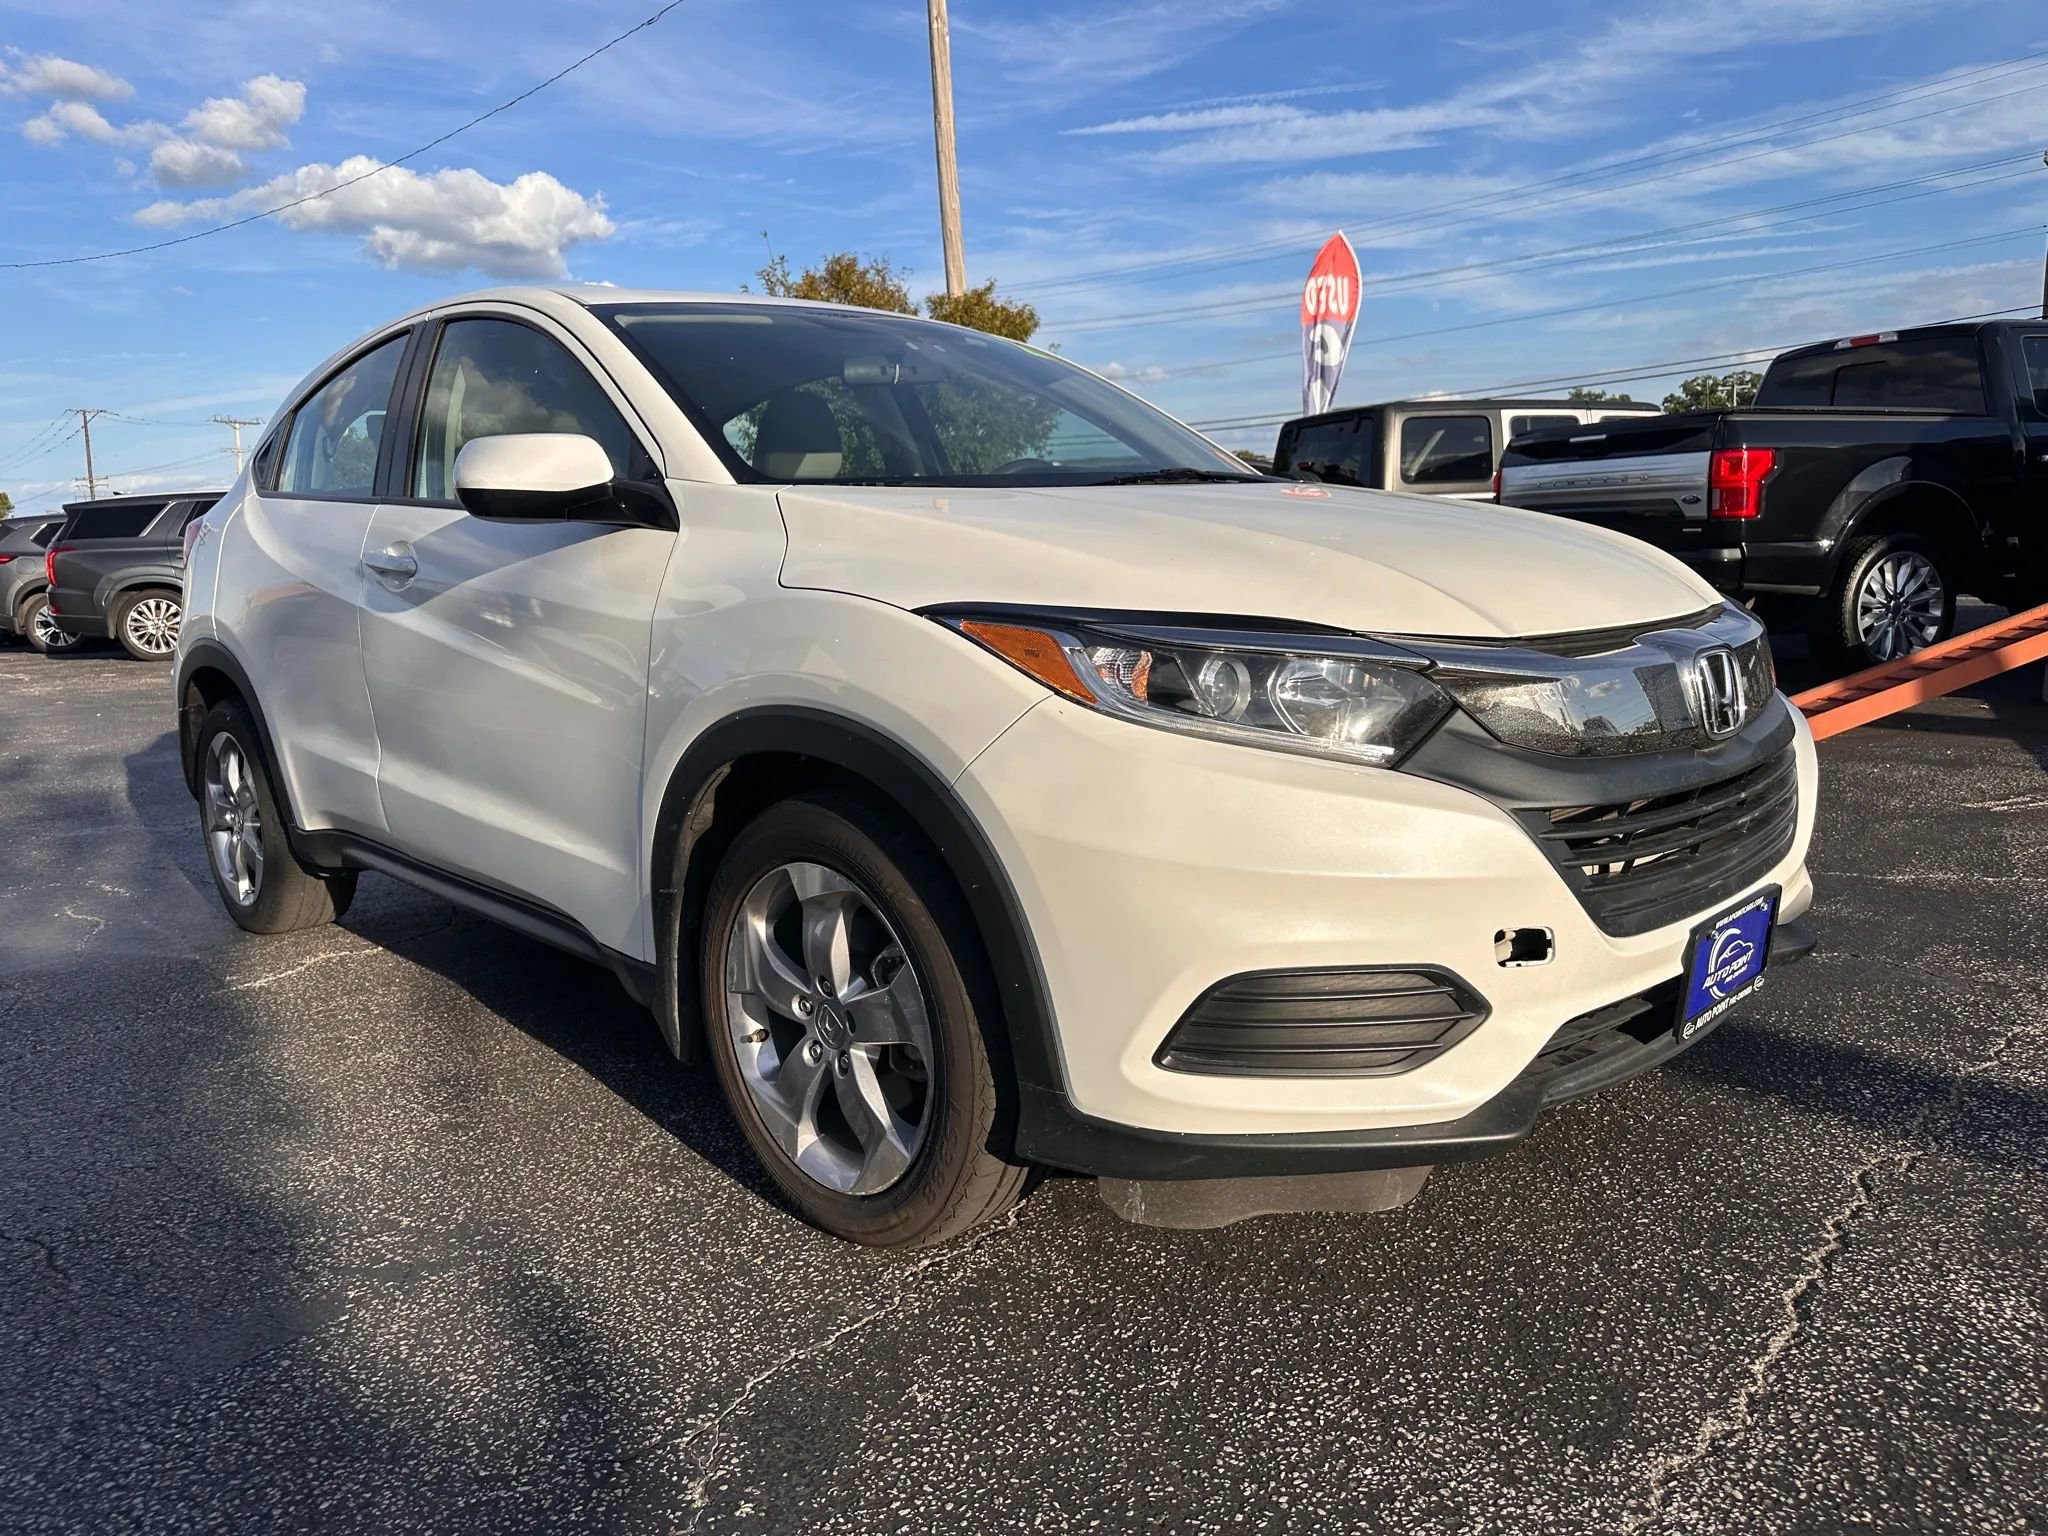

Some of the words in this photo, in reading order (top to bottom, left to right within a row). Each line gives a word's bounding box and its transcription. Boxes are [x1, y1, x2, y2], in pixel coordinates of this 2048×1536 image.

[1702, 965, 1731, 990] AUTO
[1728, 949, 1754, 974] POINT
[1695, 1010, 1712, 1030] AUTO
[1712, 997, 1730, 1019] POINT
